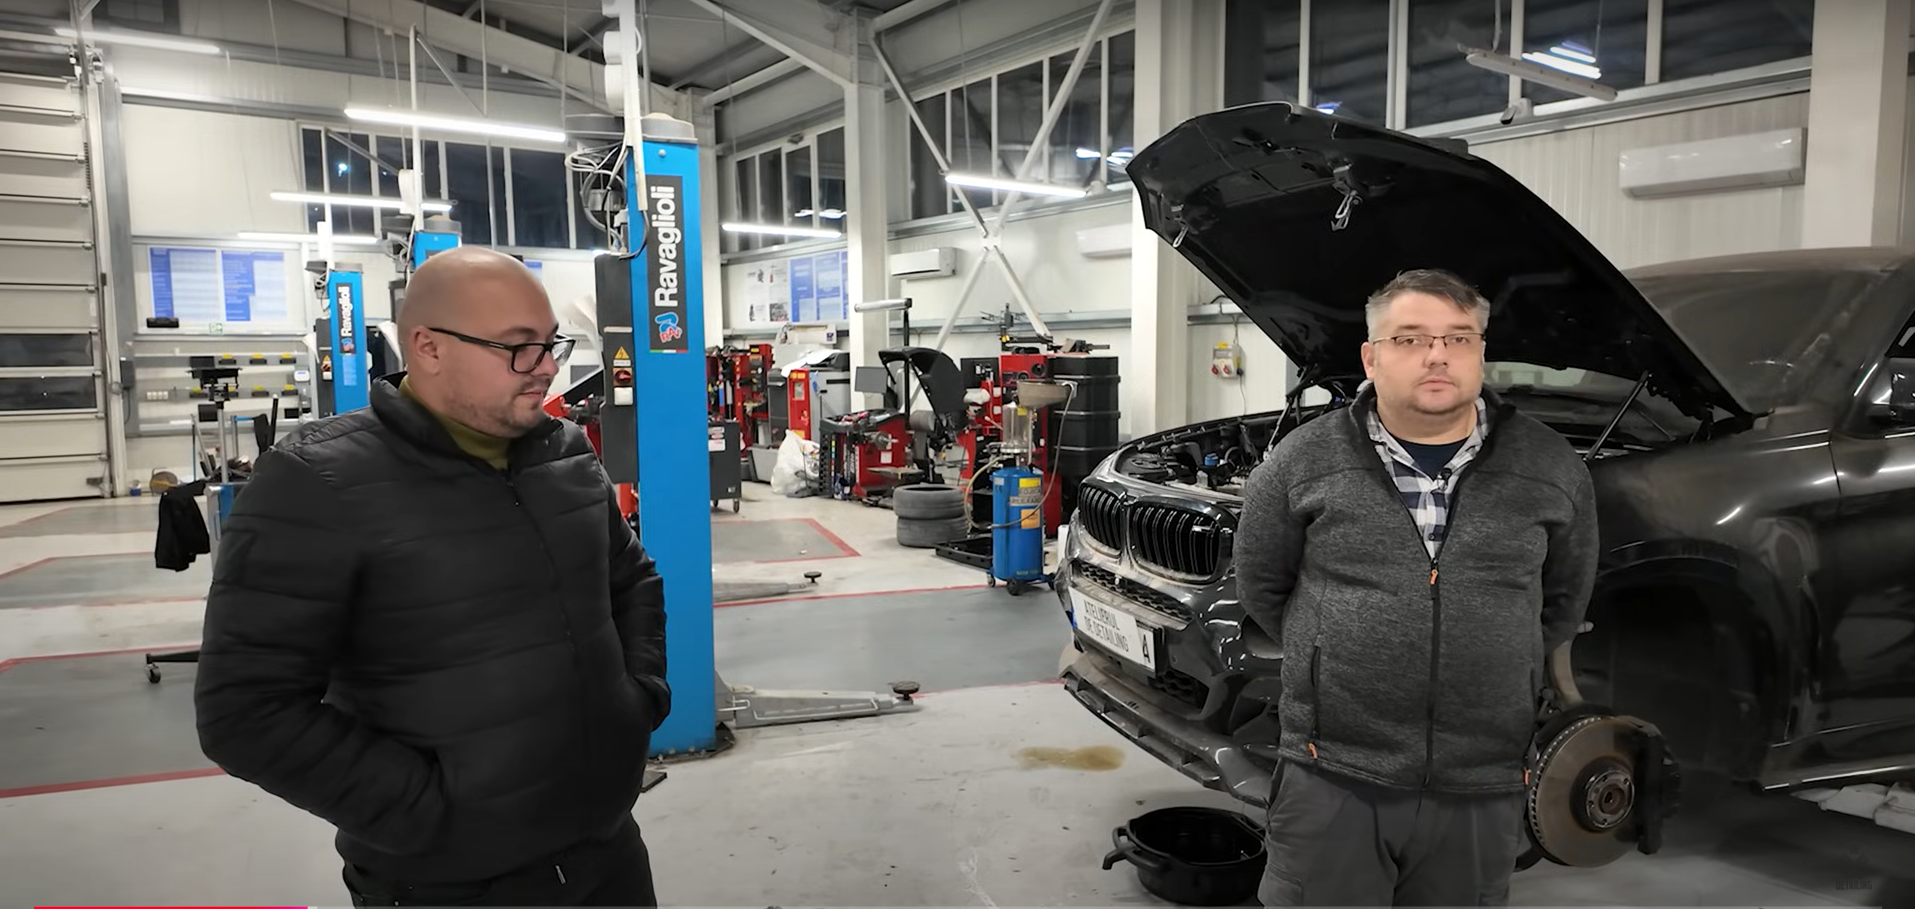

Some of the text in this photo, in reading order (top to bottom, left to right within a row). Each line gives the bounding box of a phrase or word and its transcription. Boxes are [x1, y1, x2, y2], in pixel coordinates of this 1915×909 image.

[650, 186, 682, 307] Ravaglioli
[1083, 600, 1120, 631] ATELIERUL
[1084, 616, 1129, 652] DE DETAILING
